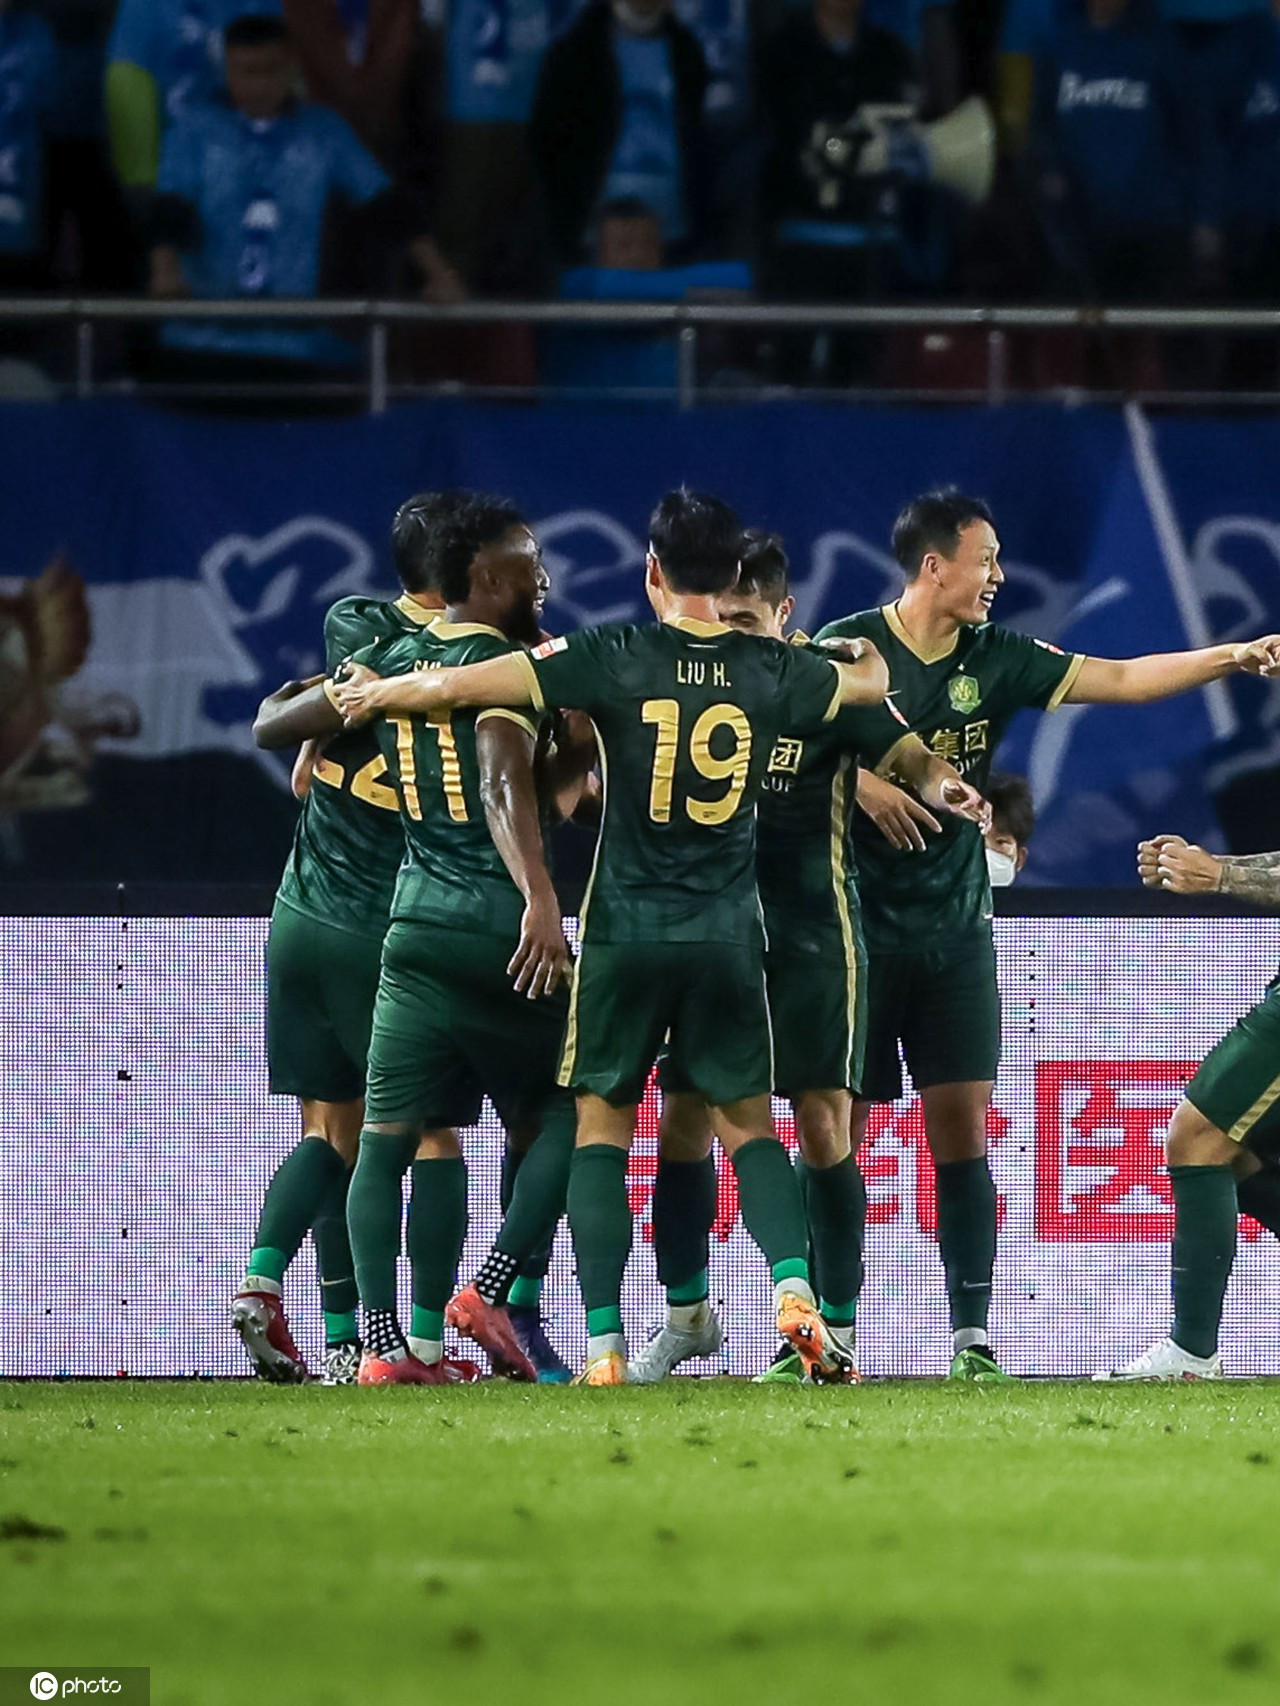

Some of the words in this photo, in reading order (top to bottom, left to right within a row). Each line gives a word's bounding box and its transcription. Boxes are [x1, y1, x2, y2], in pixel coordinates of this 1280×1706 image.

[677, 659, 705, 685] LIU
[713, 662, 732, 687] H.
[386, 706, 469, 821] 11
[641, 699, 752, 825] 19
